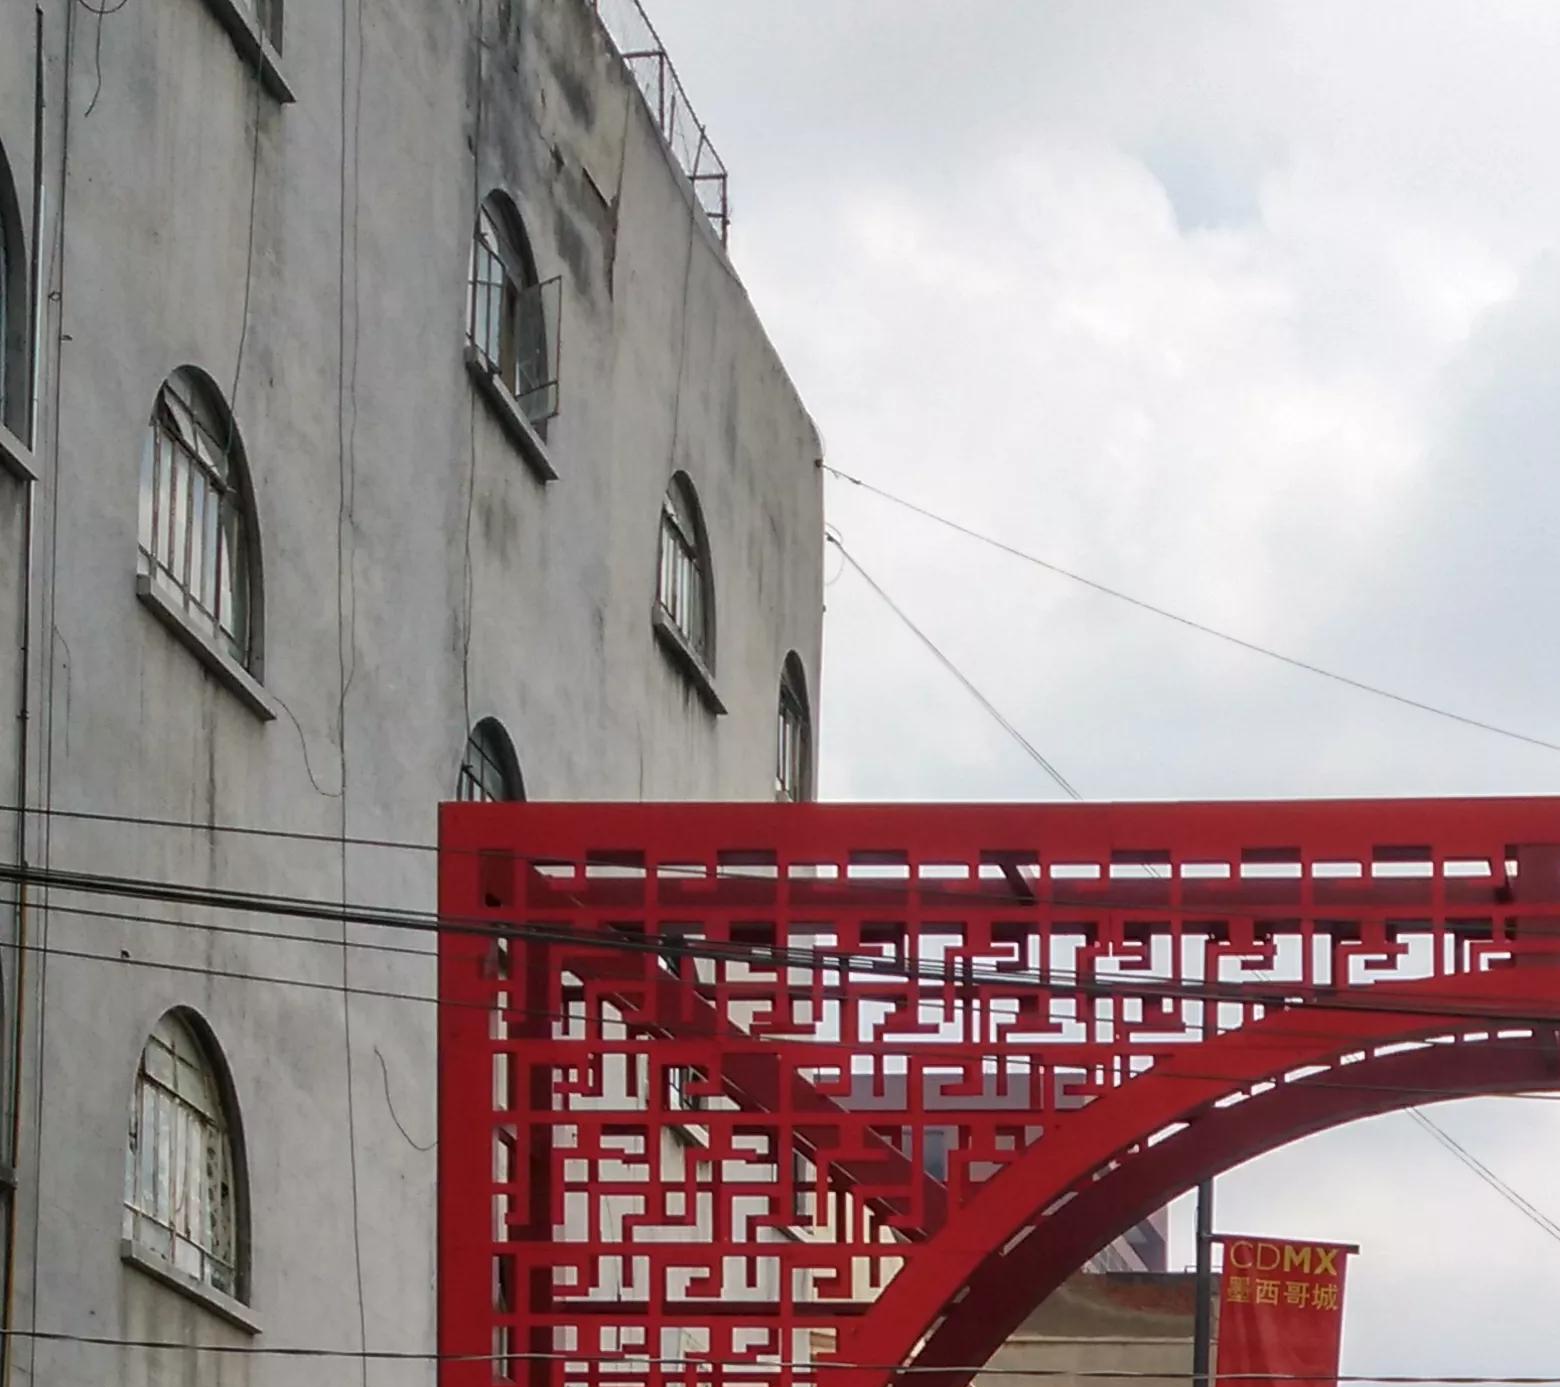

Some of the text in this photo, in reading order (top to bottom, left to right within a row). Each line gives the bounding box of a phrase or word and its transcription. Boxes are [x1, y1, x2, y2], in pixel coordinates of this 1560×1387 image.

[1230, 1241, 1338, 1275] CDMX
[1227, 1276, 1339, 1310] 墨西哥城
